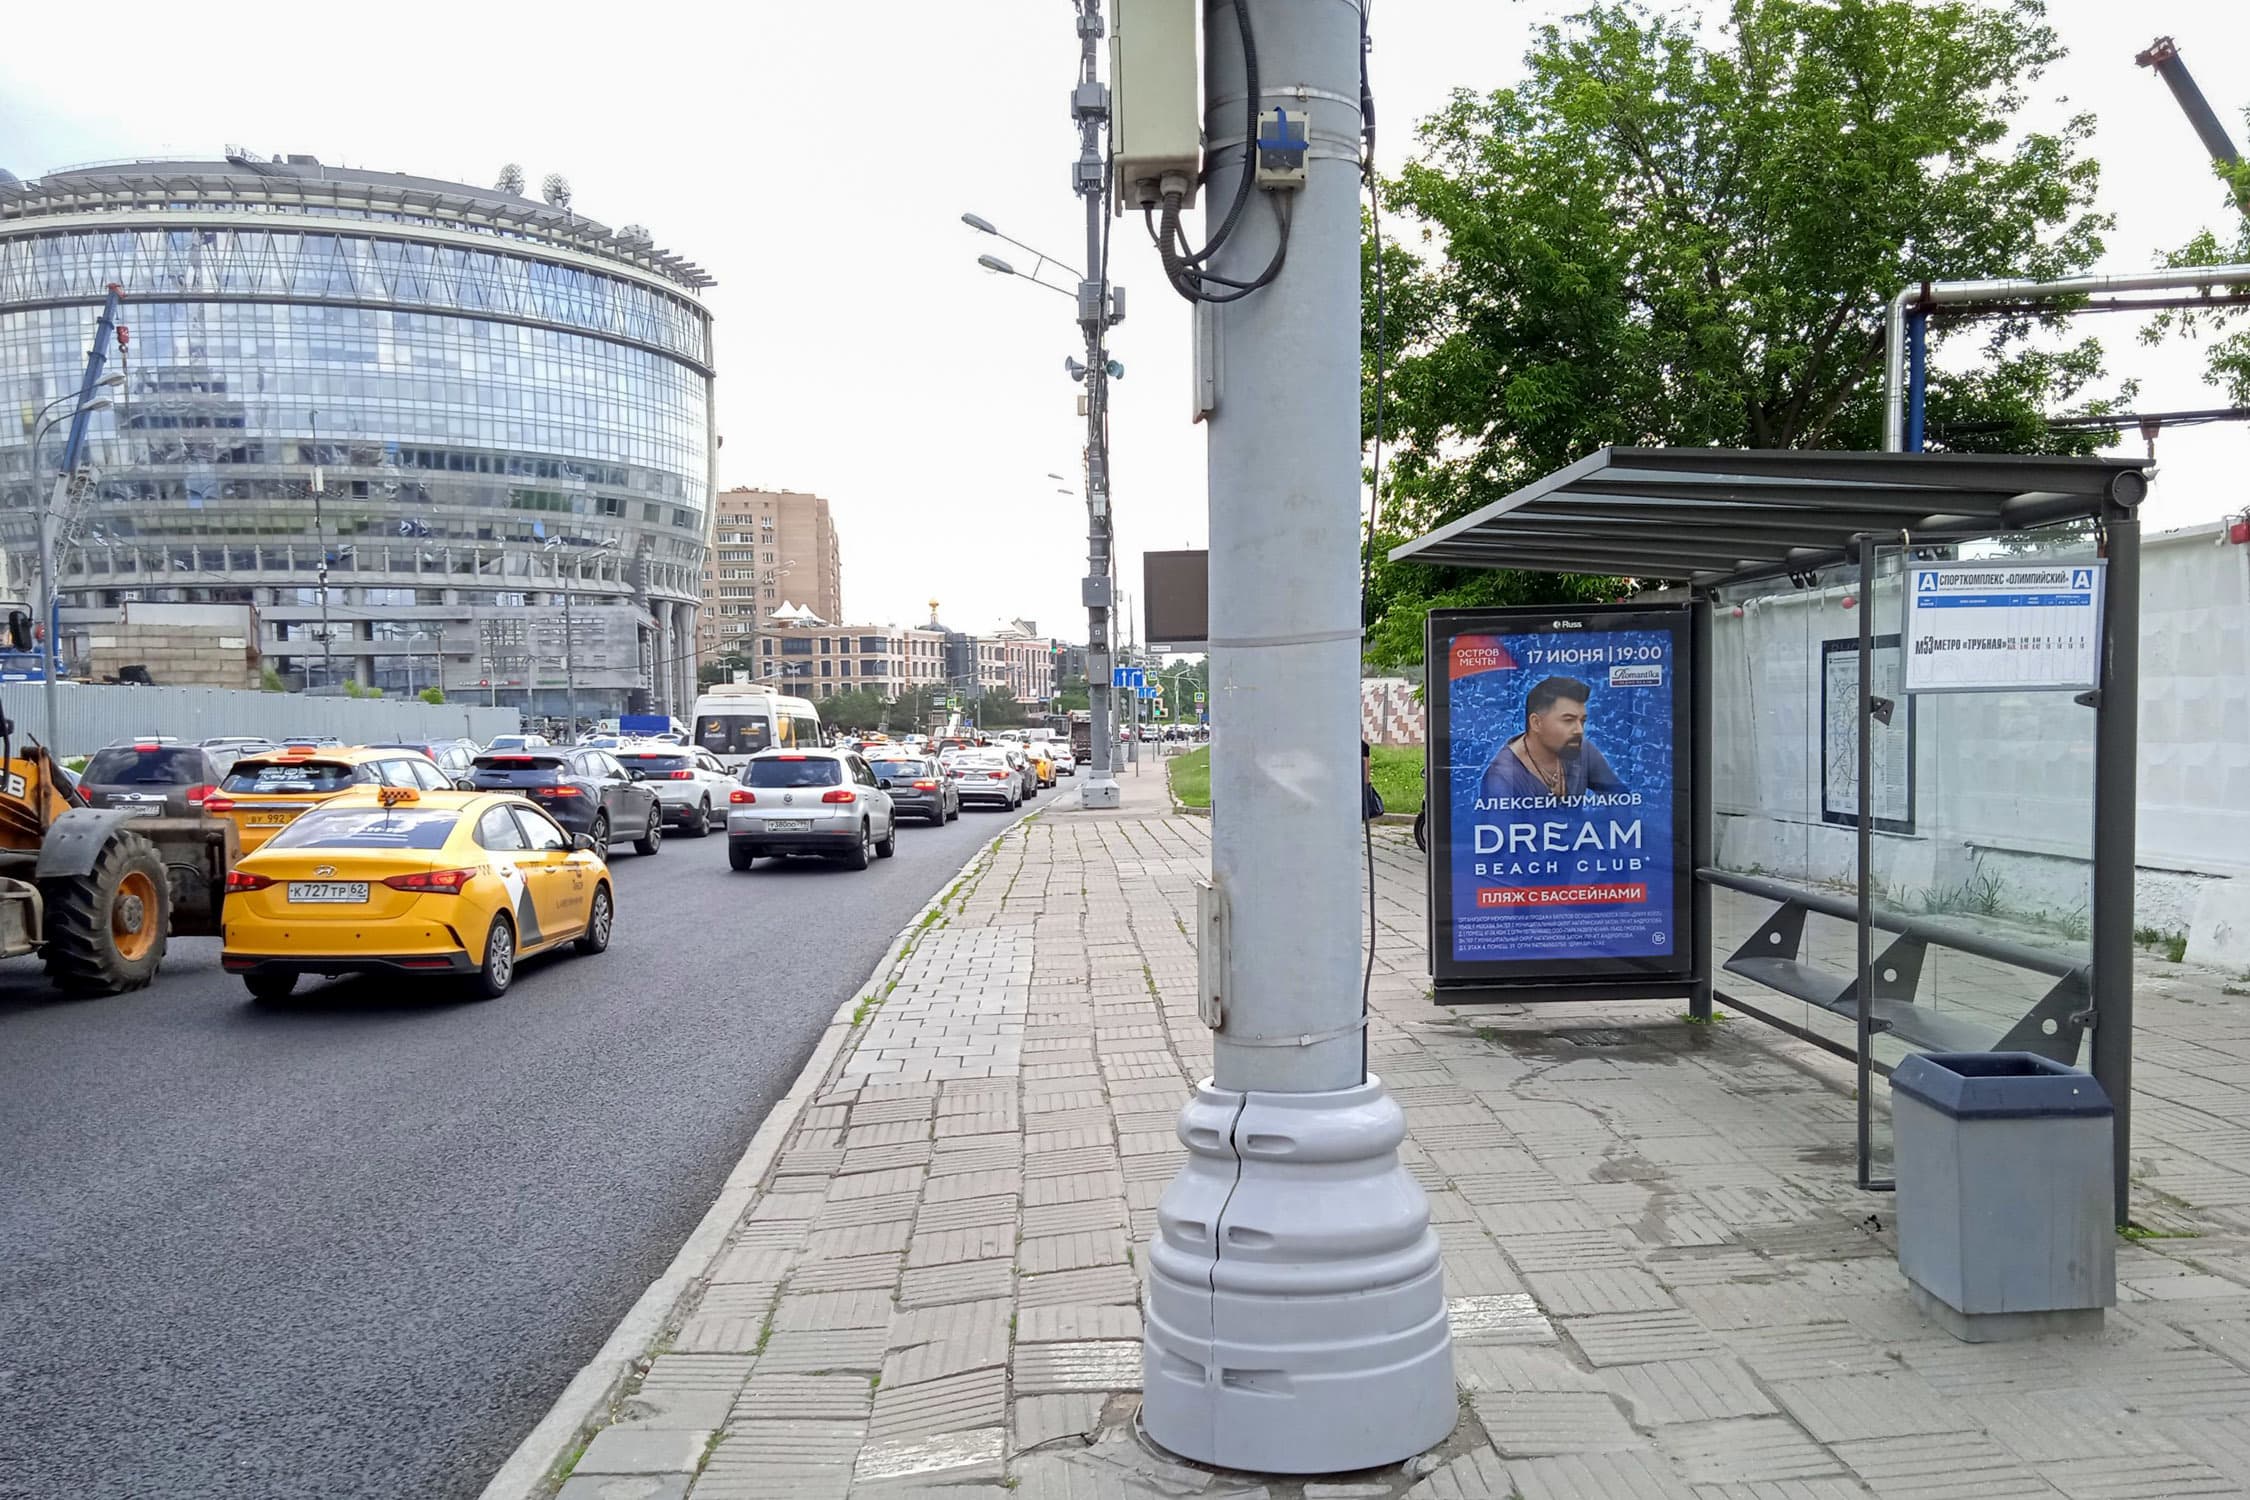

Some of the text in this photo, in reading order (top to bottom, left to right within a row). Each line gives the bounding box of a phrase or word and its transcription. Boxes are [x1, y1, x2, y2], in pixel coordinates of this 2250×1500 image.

[1939, 574, 2005, 585] СПОРТКОМПЛЕКС
[1562, 620, 1582, 628] Russ
[1934, 639, 1961, 650] МЕТРО
[1962, 639, 2007, 650] «ТРУБНАЯ»
[1457, 649, 1499, 658] ОСТРОВ
[1527, 646, 1661, 664] 17 ИЮНЯ 19:00
[1460, 658, 1496, 666] МЕЧТЫ
[1474, 793, 1642, 810] АЛЕКСЕЙ ЧУМАКОВ
[1474, 819, 1642, 854] DREAM
[1475, 861, 1558, 876] BEACH
[1482, 887, 1641, 903] ПЛЯЖ С БАССЕЙНАМИ
